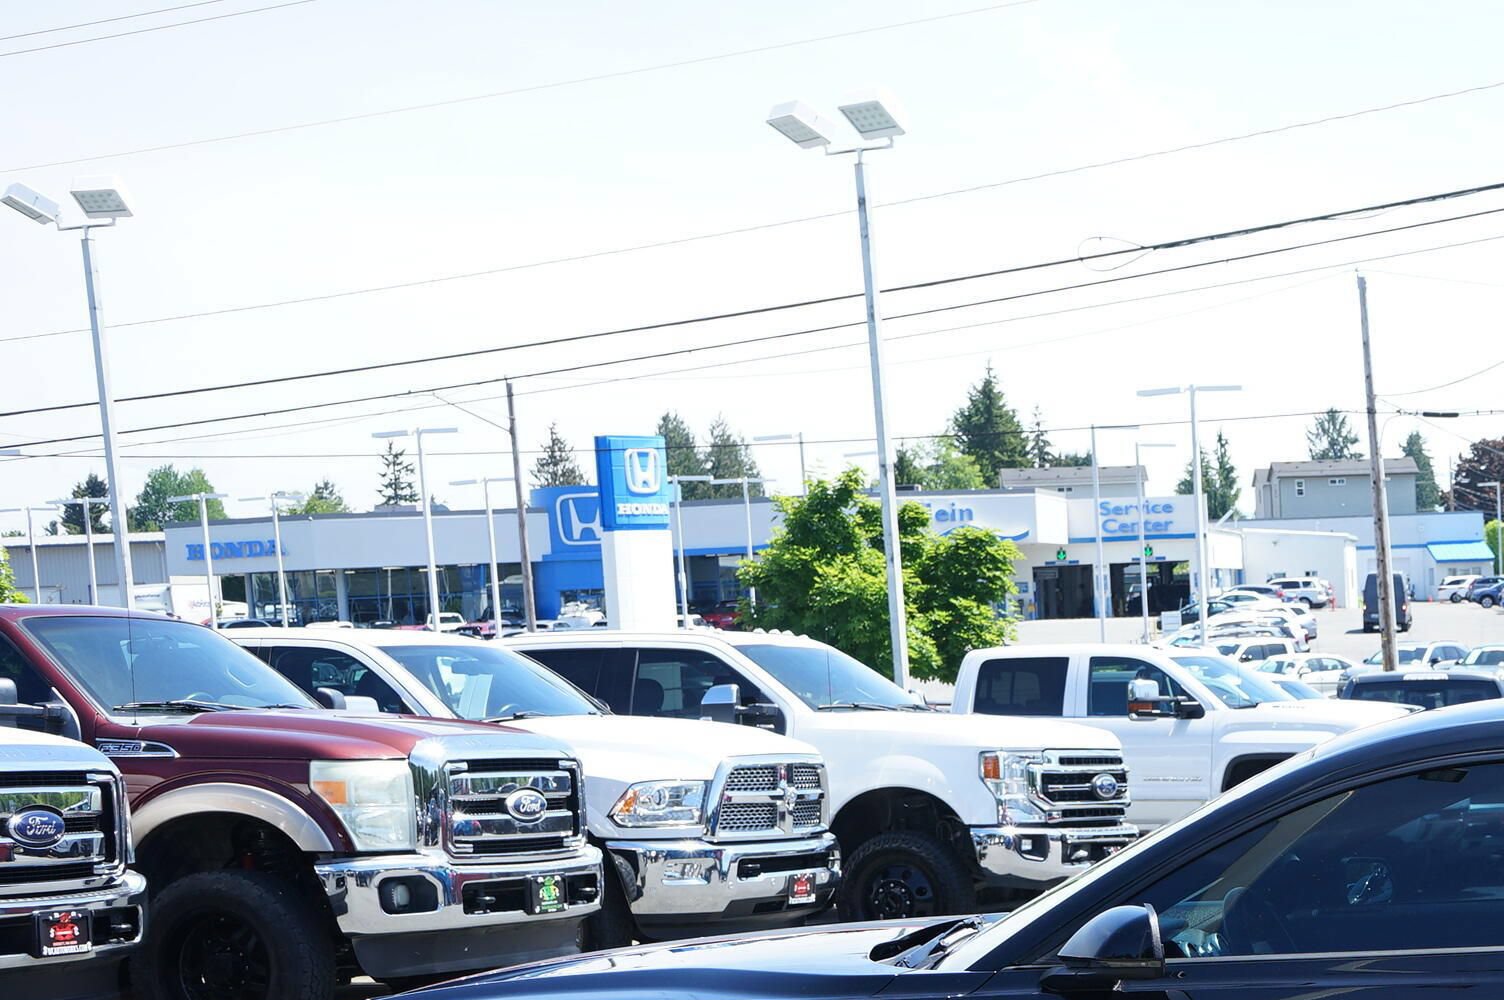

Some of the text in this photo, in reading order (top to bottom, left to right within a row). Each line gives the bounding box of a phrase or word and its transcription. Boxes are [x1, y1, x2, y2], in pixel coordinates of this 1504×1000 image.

[617, 503, 668, 515] HONDA
[1099, 500, 1174, 516] Service
[1102, 518, 1174, 533] Center
[185, 539, 287, 560] HONDA
[519, 796, 541, 813] Ford
[26, 816, 57, 836] Ford
